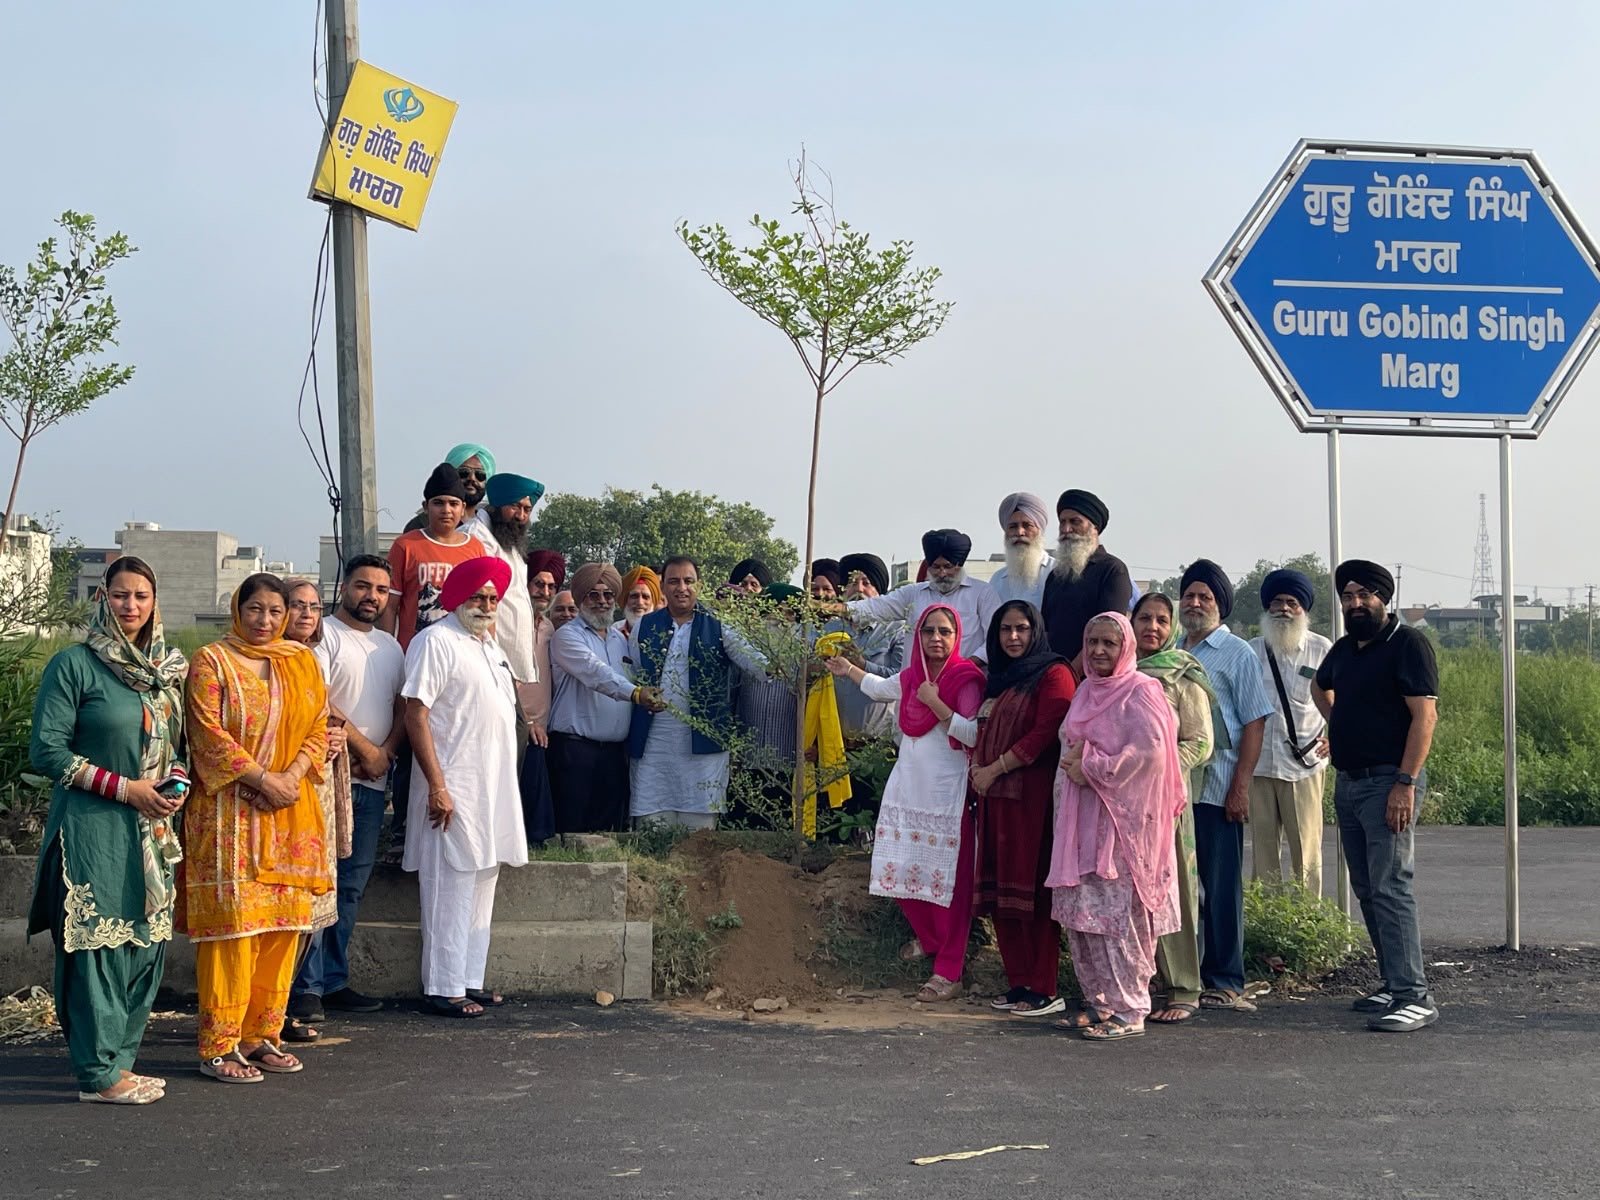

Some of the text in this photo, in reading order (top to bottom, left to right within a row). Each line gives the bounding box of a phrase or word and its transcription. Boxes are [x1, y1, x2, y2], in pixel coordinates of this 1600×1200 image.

[338, 117, 434, 178] ਗੁਰੂ ਗੋਬਿੰਦ ਸਿੰਘ
[349, 166, 404, 209] ਮਾਰਗ
[1303, 171, 1531, 233] ਗੁਰੂ ਗੋਬਿੰਦ ਸਿੰਘ
[1375, 240, 1461, 274] ਮਾਰਗ
[1272, 300, 1565, 351] Guru Gobind Singh
[1381, 353, 1460, 399] Marg
